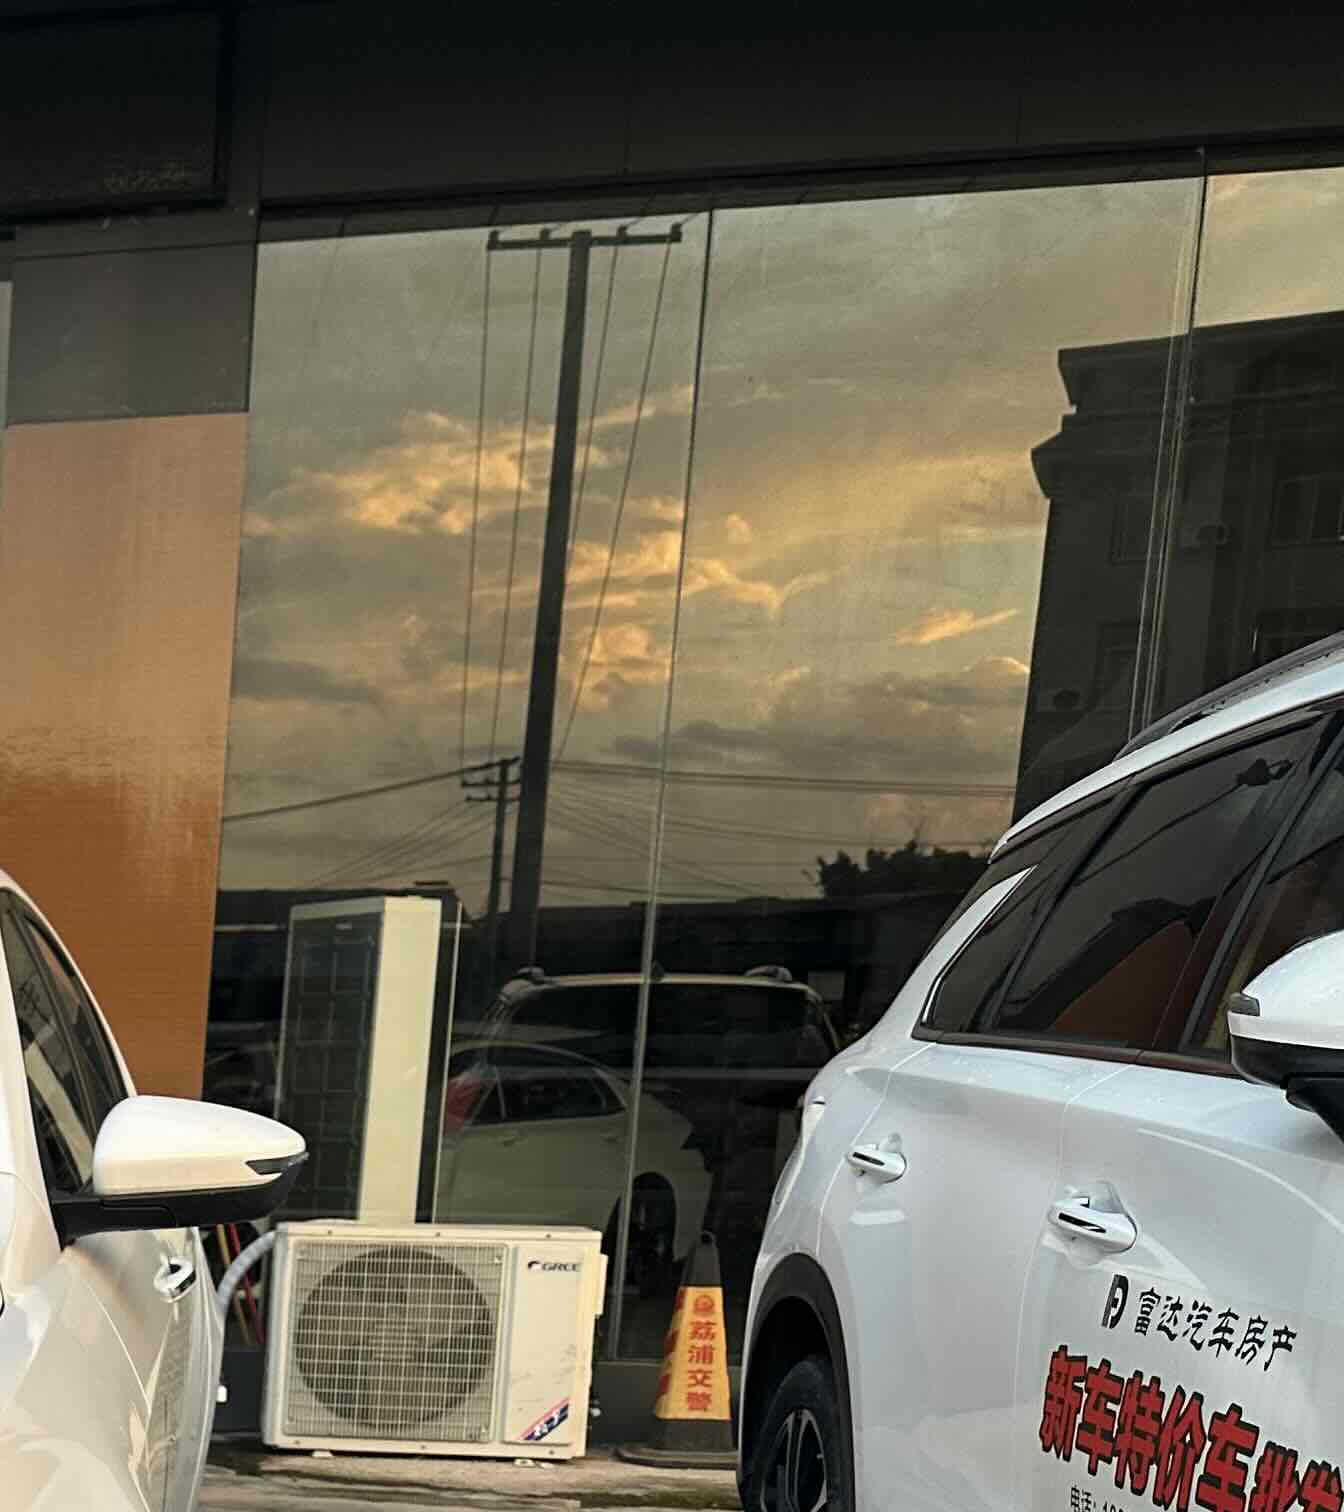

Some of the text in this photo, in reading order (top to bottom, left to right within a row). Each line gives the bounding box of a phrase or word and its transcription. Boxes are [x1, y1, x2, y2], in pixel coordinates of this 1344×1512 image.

[1133, 1287, 1297, 1372] 富达汽车房产
